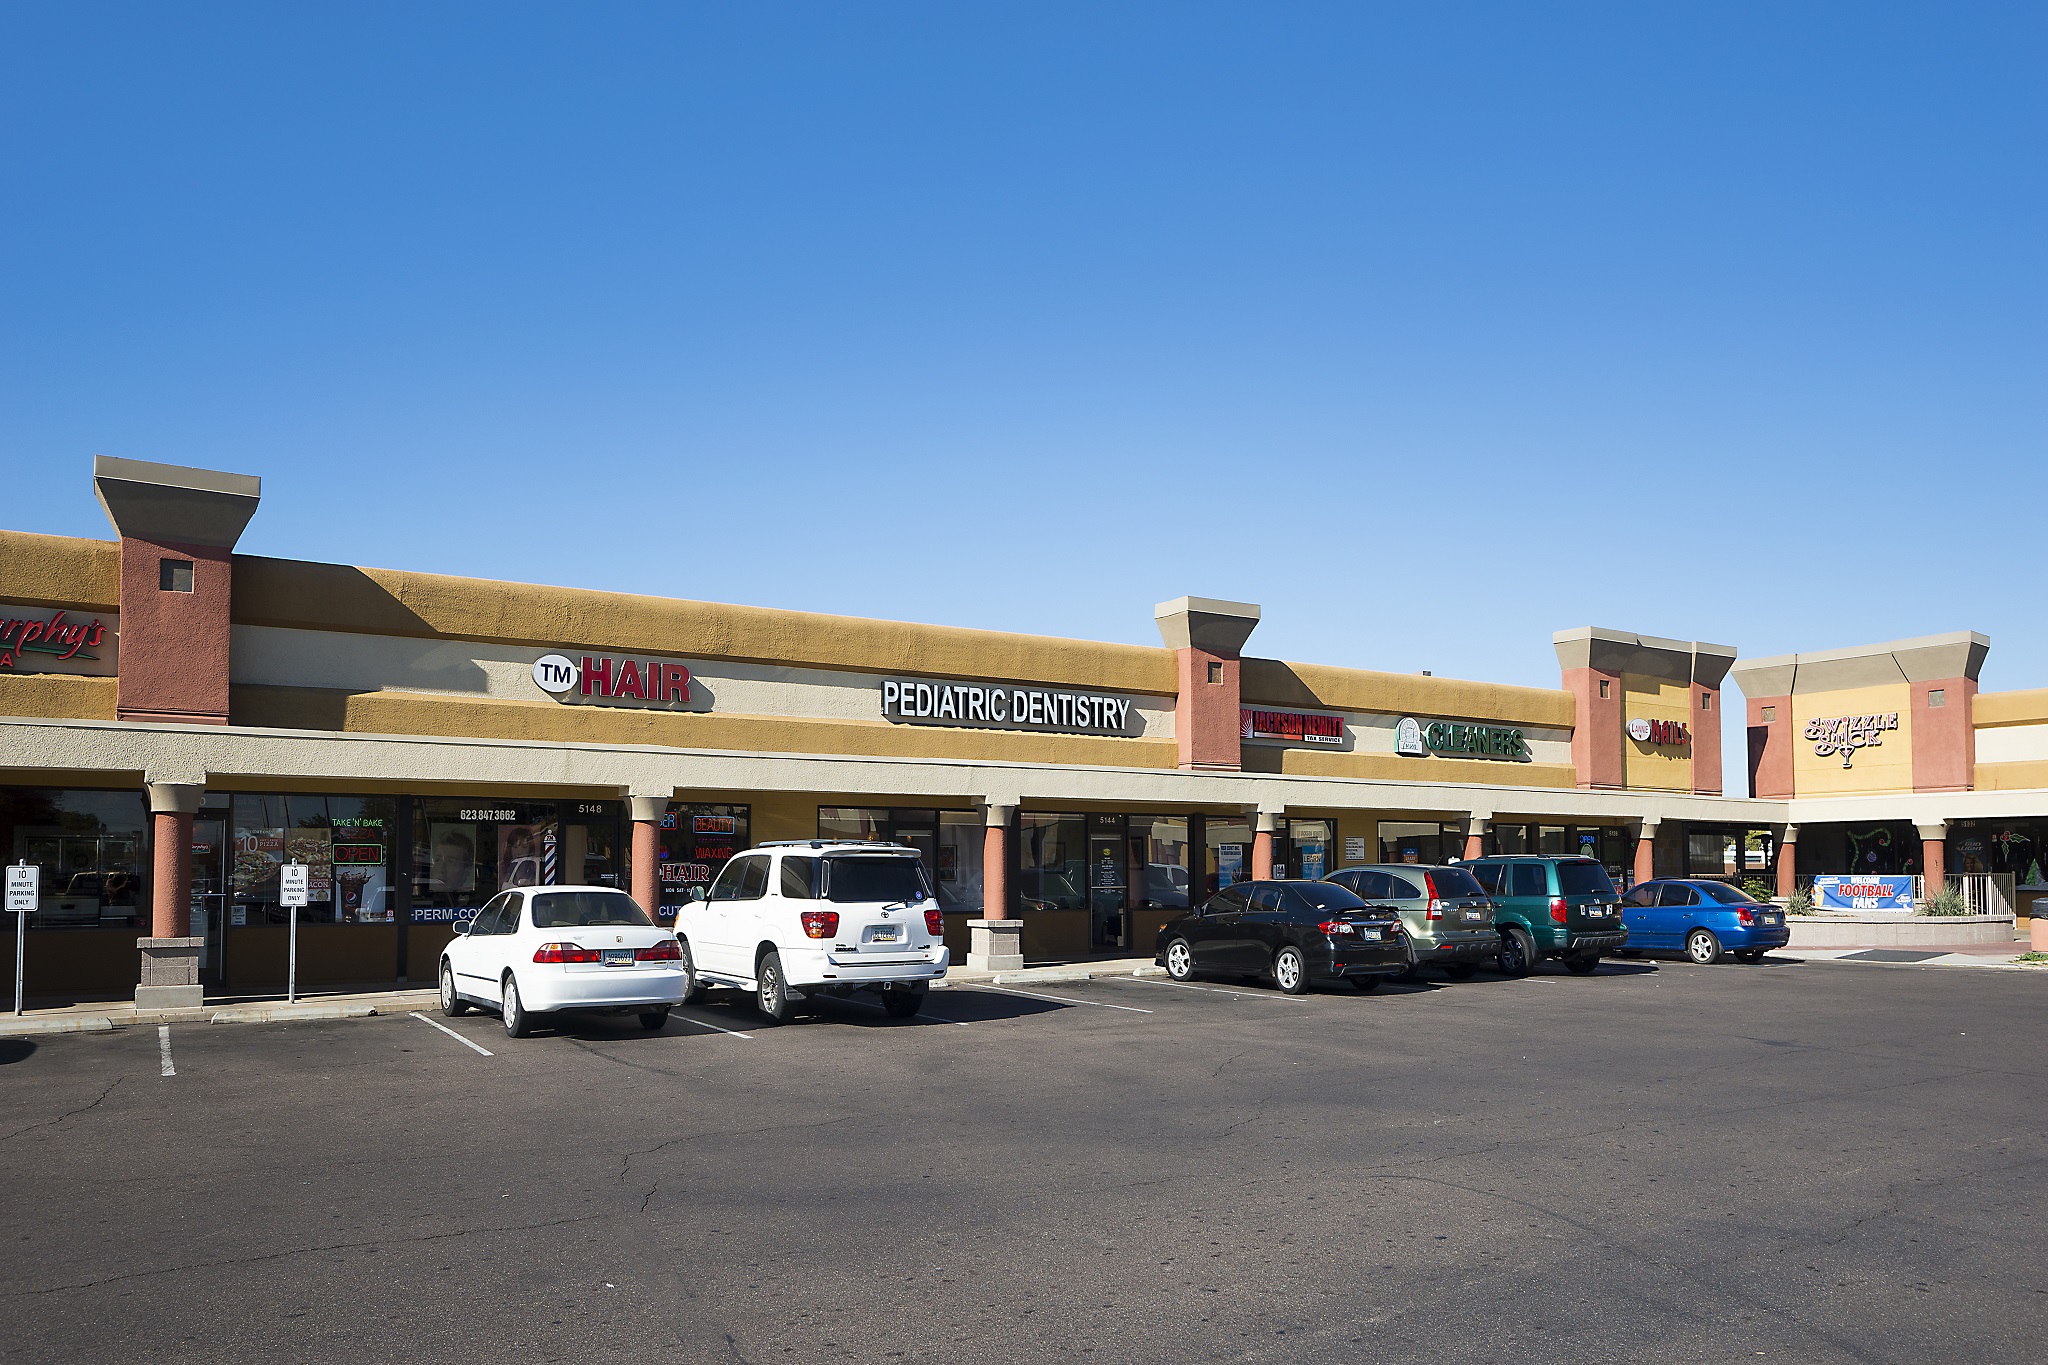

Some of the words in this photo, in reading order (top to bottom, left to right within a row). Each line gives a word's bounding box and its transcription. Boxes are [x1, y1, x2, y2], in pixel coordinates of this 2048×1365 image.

[0, 611, 107, 660] rphy's
[541, 663, 571, 684] TM
[581, 656, 691, 702] HAIR
[883, 681, 1006, 722] PEDIATRIC
[1012, 690, 1130, 730] DENTISTRY
[1254, 710, 1303, 735] JACKSON
[1304, 714, 1344, 737] HEWITT
[1804, 712, 1898, 740] SWIZZLE
[1427, 722, 1525, 757] CLEANERS
[1651, 719, 1688, 746] NAILS
[1814, 730, 1883, 757] STICK
[460, 809, 516, 821] 623.847.3662
[578, 804, 602, 814] 5148
[332, 818, 351, 827] TAKE
[363, 819, 383, 827] BAKE
[660, 813, 676, 828] ER
[695, 817, 732, 832] BEAUTY
[1100, 816, 1115, 824] 5144
[340, 828, 376, 840] PIZZA
[1580, 835, 1595, 844] OPEN
[335, 846, 380, 861] OPEN
[1303, 854, 1322, 863] LEARN
[18, 870, 27, 879] 10
[291, 868, 299, 877] 10
[662, 863, 710, 882] HAIR
[1850, 876, 1880, 885] WELCOME
[1838, 883, 1894, 898] FOOTBALL
[1852, 897, 1879, 909] FANS
